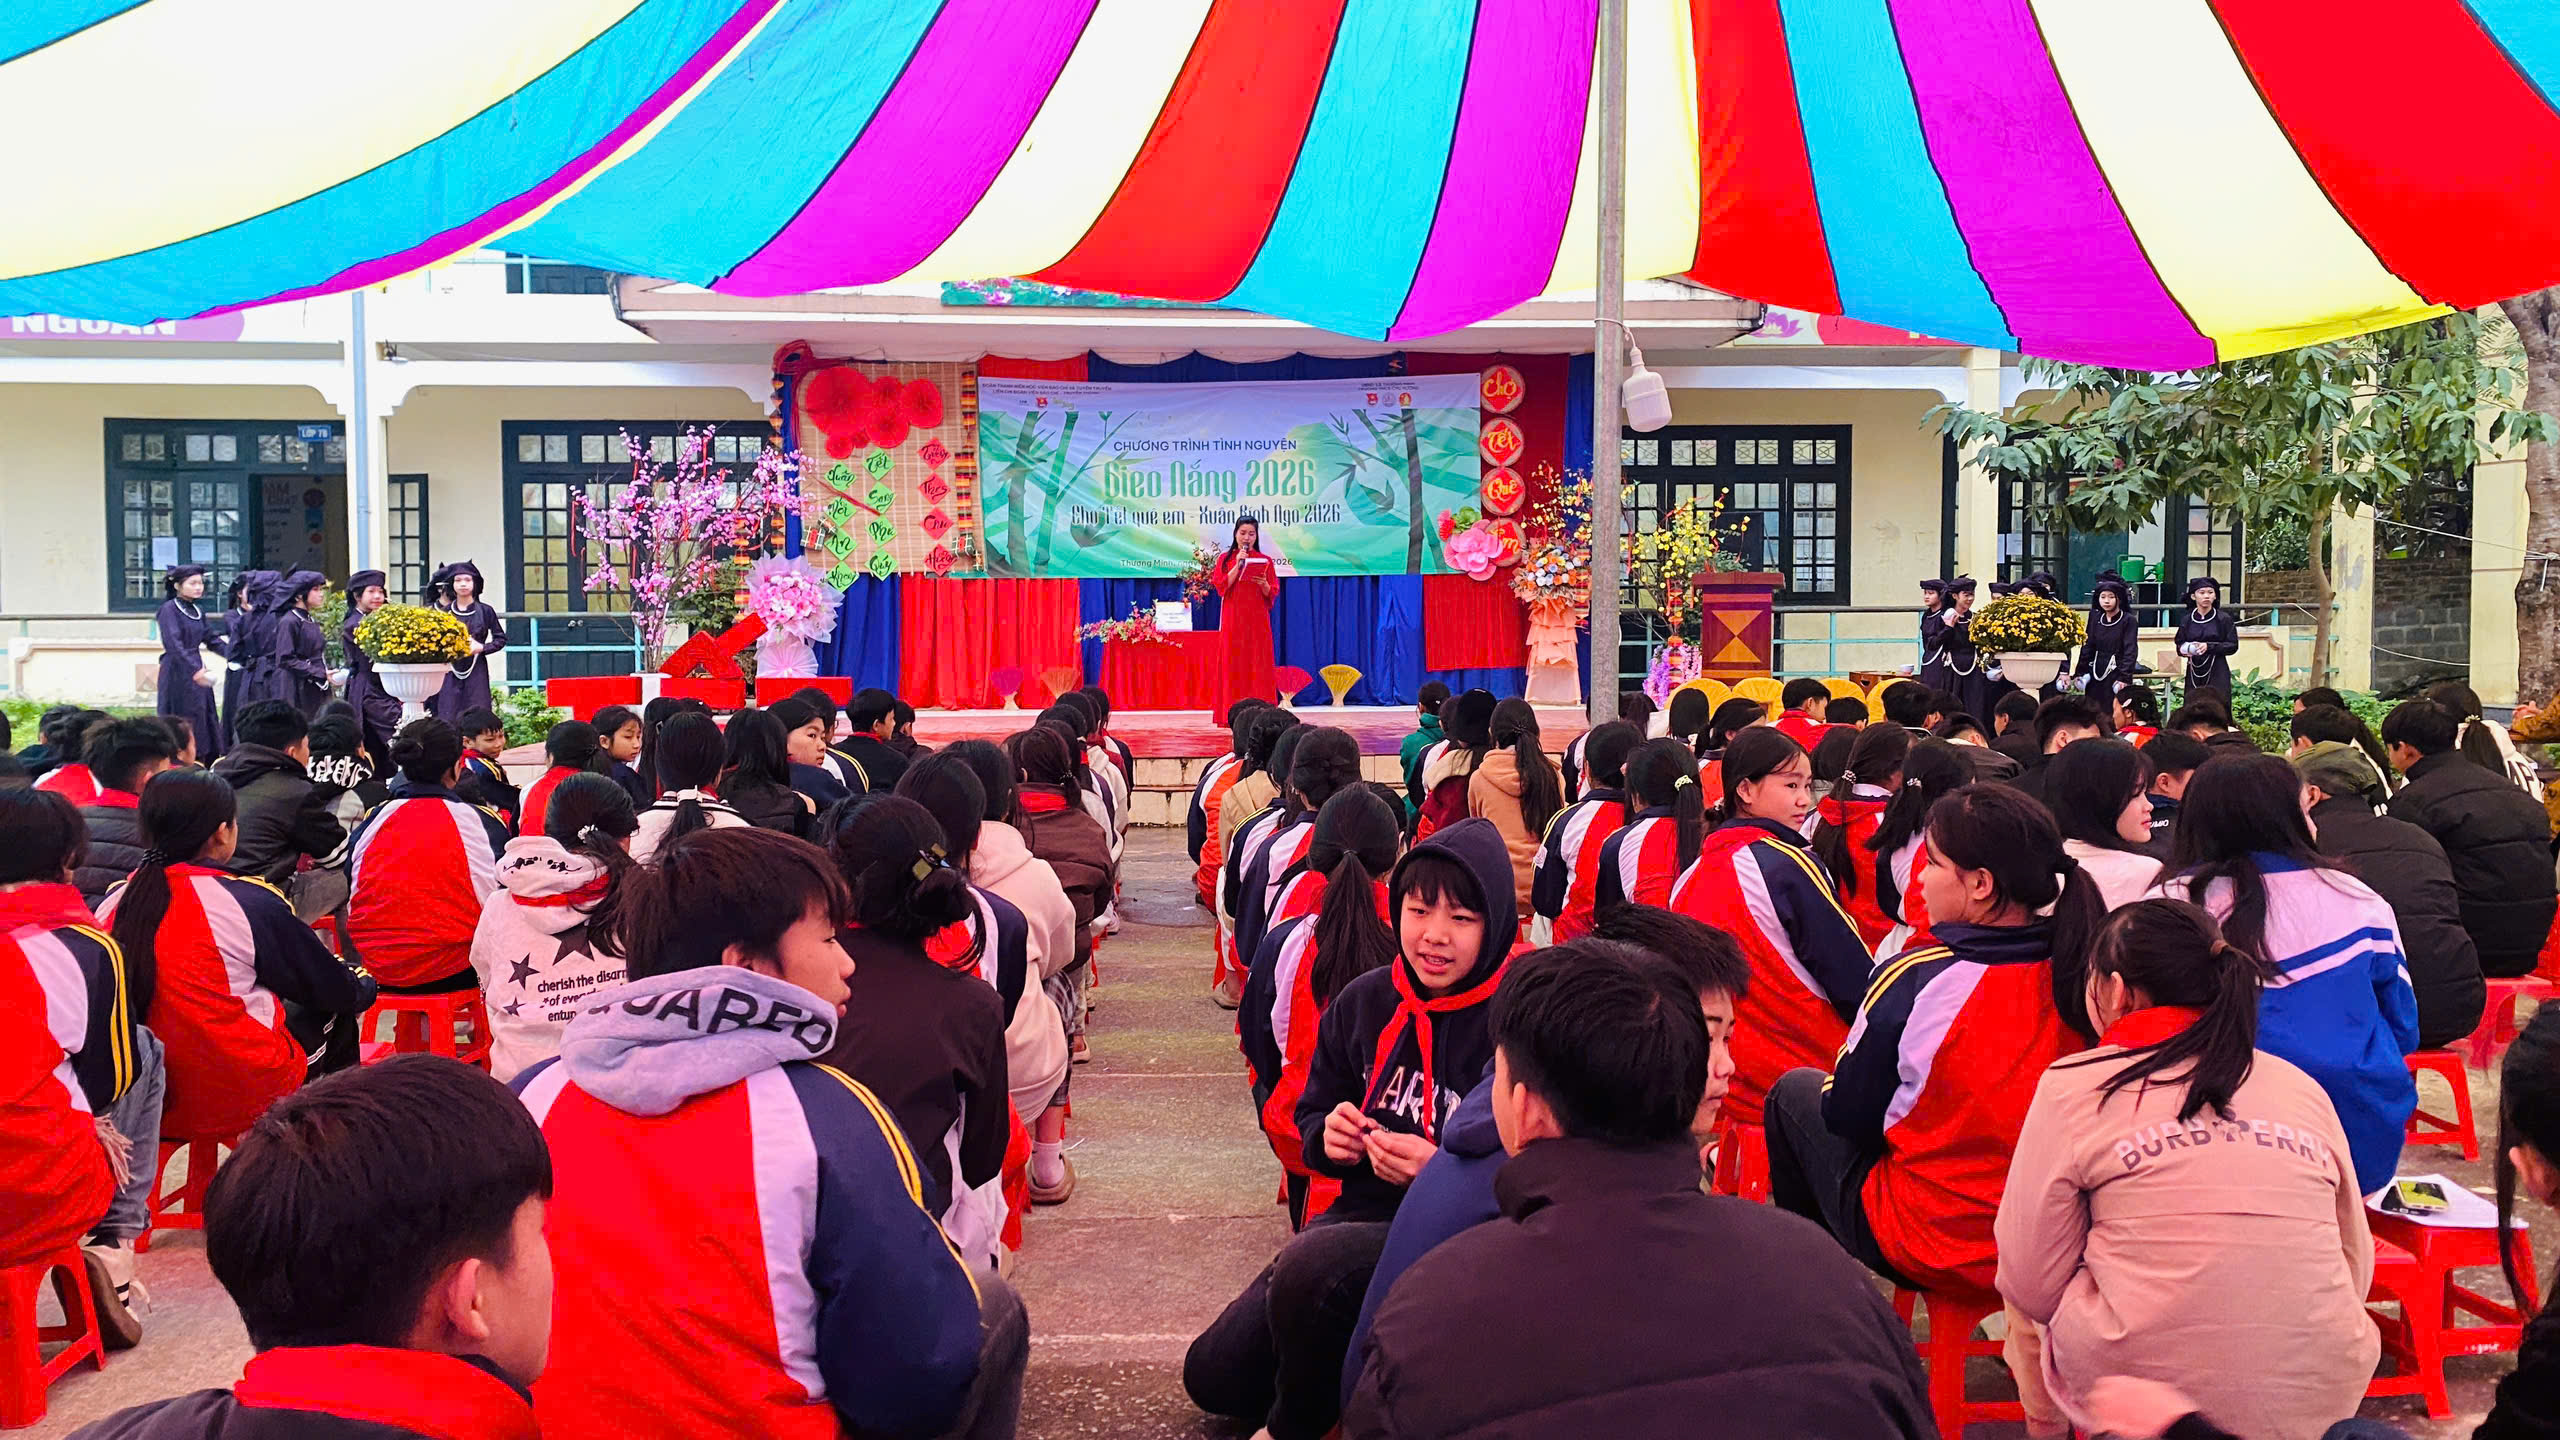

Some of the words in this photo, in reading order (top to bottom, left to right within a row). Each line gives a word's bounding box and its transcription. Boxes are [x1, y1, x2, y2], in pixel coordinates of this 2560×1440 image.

[1483, 372, 1517, 400] Chợ
[1113, 439, 1169, 451] CHƯƠNG
[1172, 438, 1210, 451] TRÌNH
[1212, 438, 1242, 451] TÌNH
[1244, 437, 1297, 453] NGUYỆN
[1488, 428, 1516, 453] Tết
[866, 452, 890, 473] Tết
[1104, 460, 1162, 498] Gieo
[1169, 458, 1237, 504] Nắng
[1245, 459, 1316, 497] 2026
[1487, 478, 1519, 501] Quê
[1132, 508, 1158, 527] quê
[1163, 510, 1185, 525] em
[1199, 505, 1235, 525] Xuân
[1304, 503, 1341, 524] 2026
[869, 555, 892, 576] Quý
[538, 978, 576, 993] cherish
[576, 974, 594, 988] the
